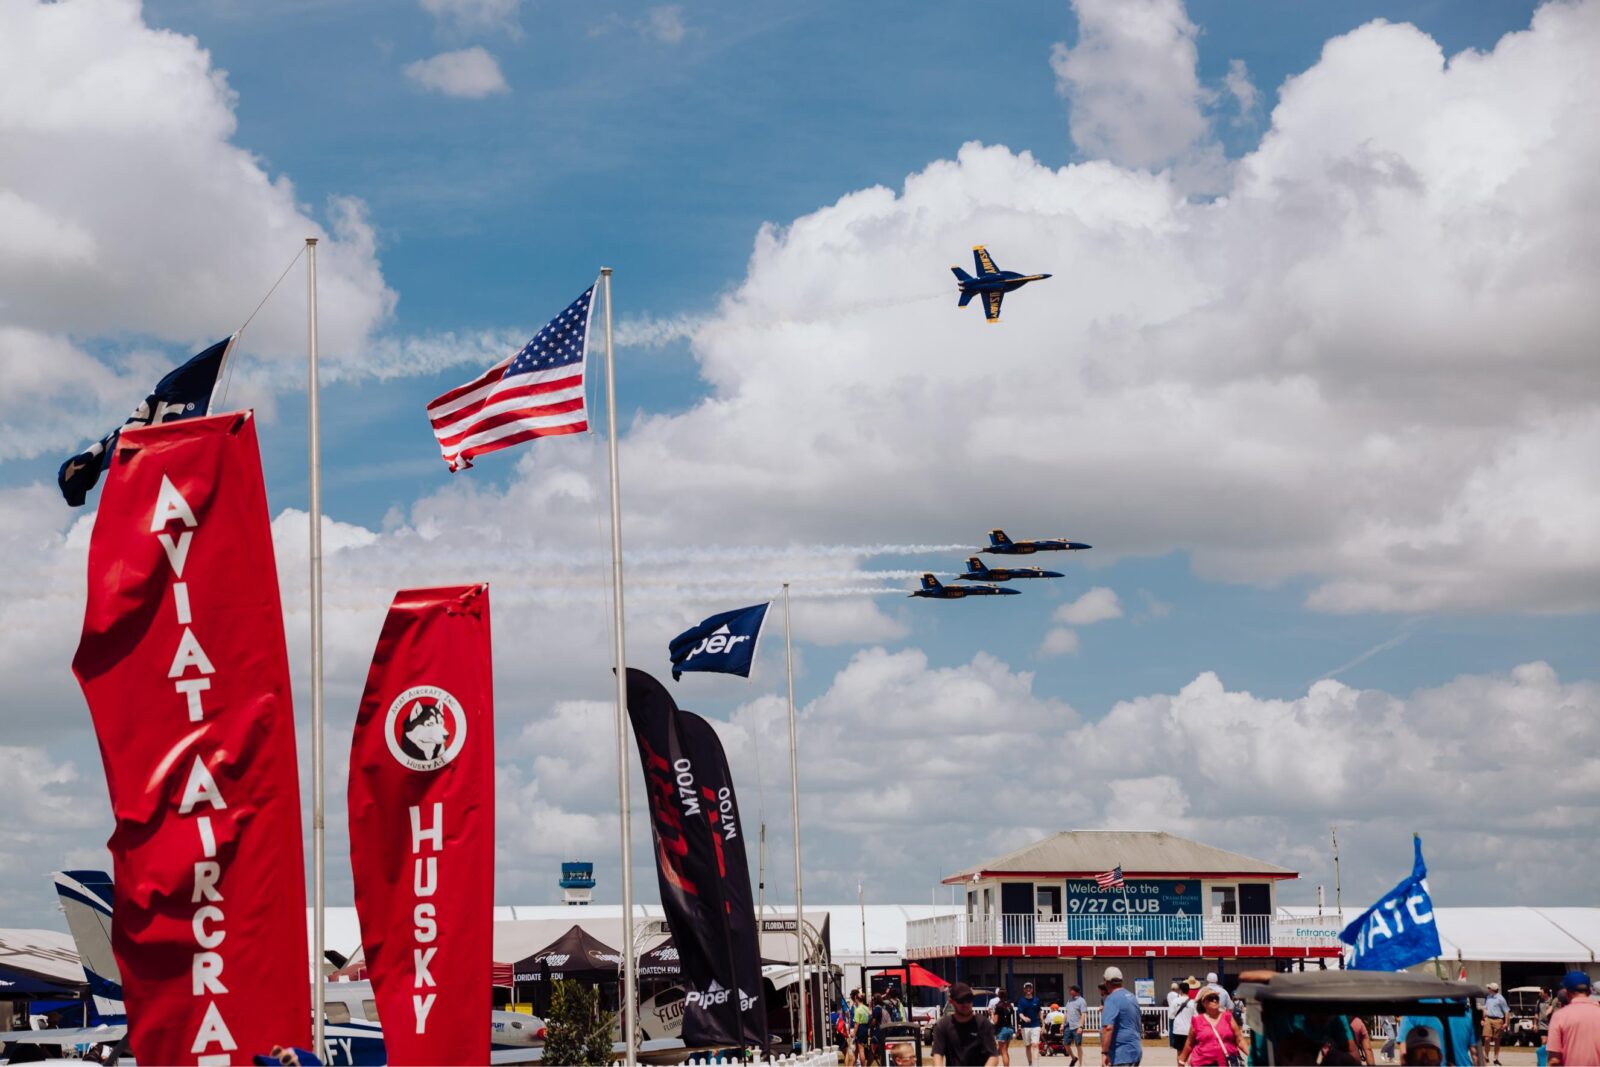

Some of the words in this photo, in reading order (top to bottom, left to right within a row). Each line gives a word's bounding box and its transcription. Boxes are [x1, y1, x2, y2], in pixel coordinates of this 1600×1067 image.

[151, 474, 216, 722] AVIAT
[674, 758, 701, 817] M700
[718, 786, 737, 841] M700
[1126, 885, 1137, 894] to
[1140, 884, 1160, 894] the
[1069, 897, 1108, 914] 9/27
[1112, 899, 1161, 913] CLUB
[409, 803, 443, 1034] HUSKY
[765, 922, 784, 930] FLORIDA
[785, 921, 797, 929] TECH
[1296, 928, 1337, 938] Entrance
[685, 988, 732, 1010] Piper
[660, 1001, 686, 1023] FLOR
